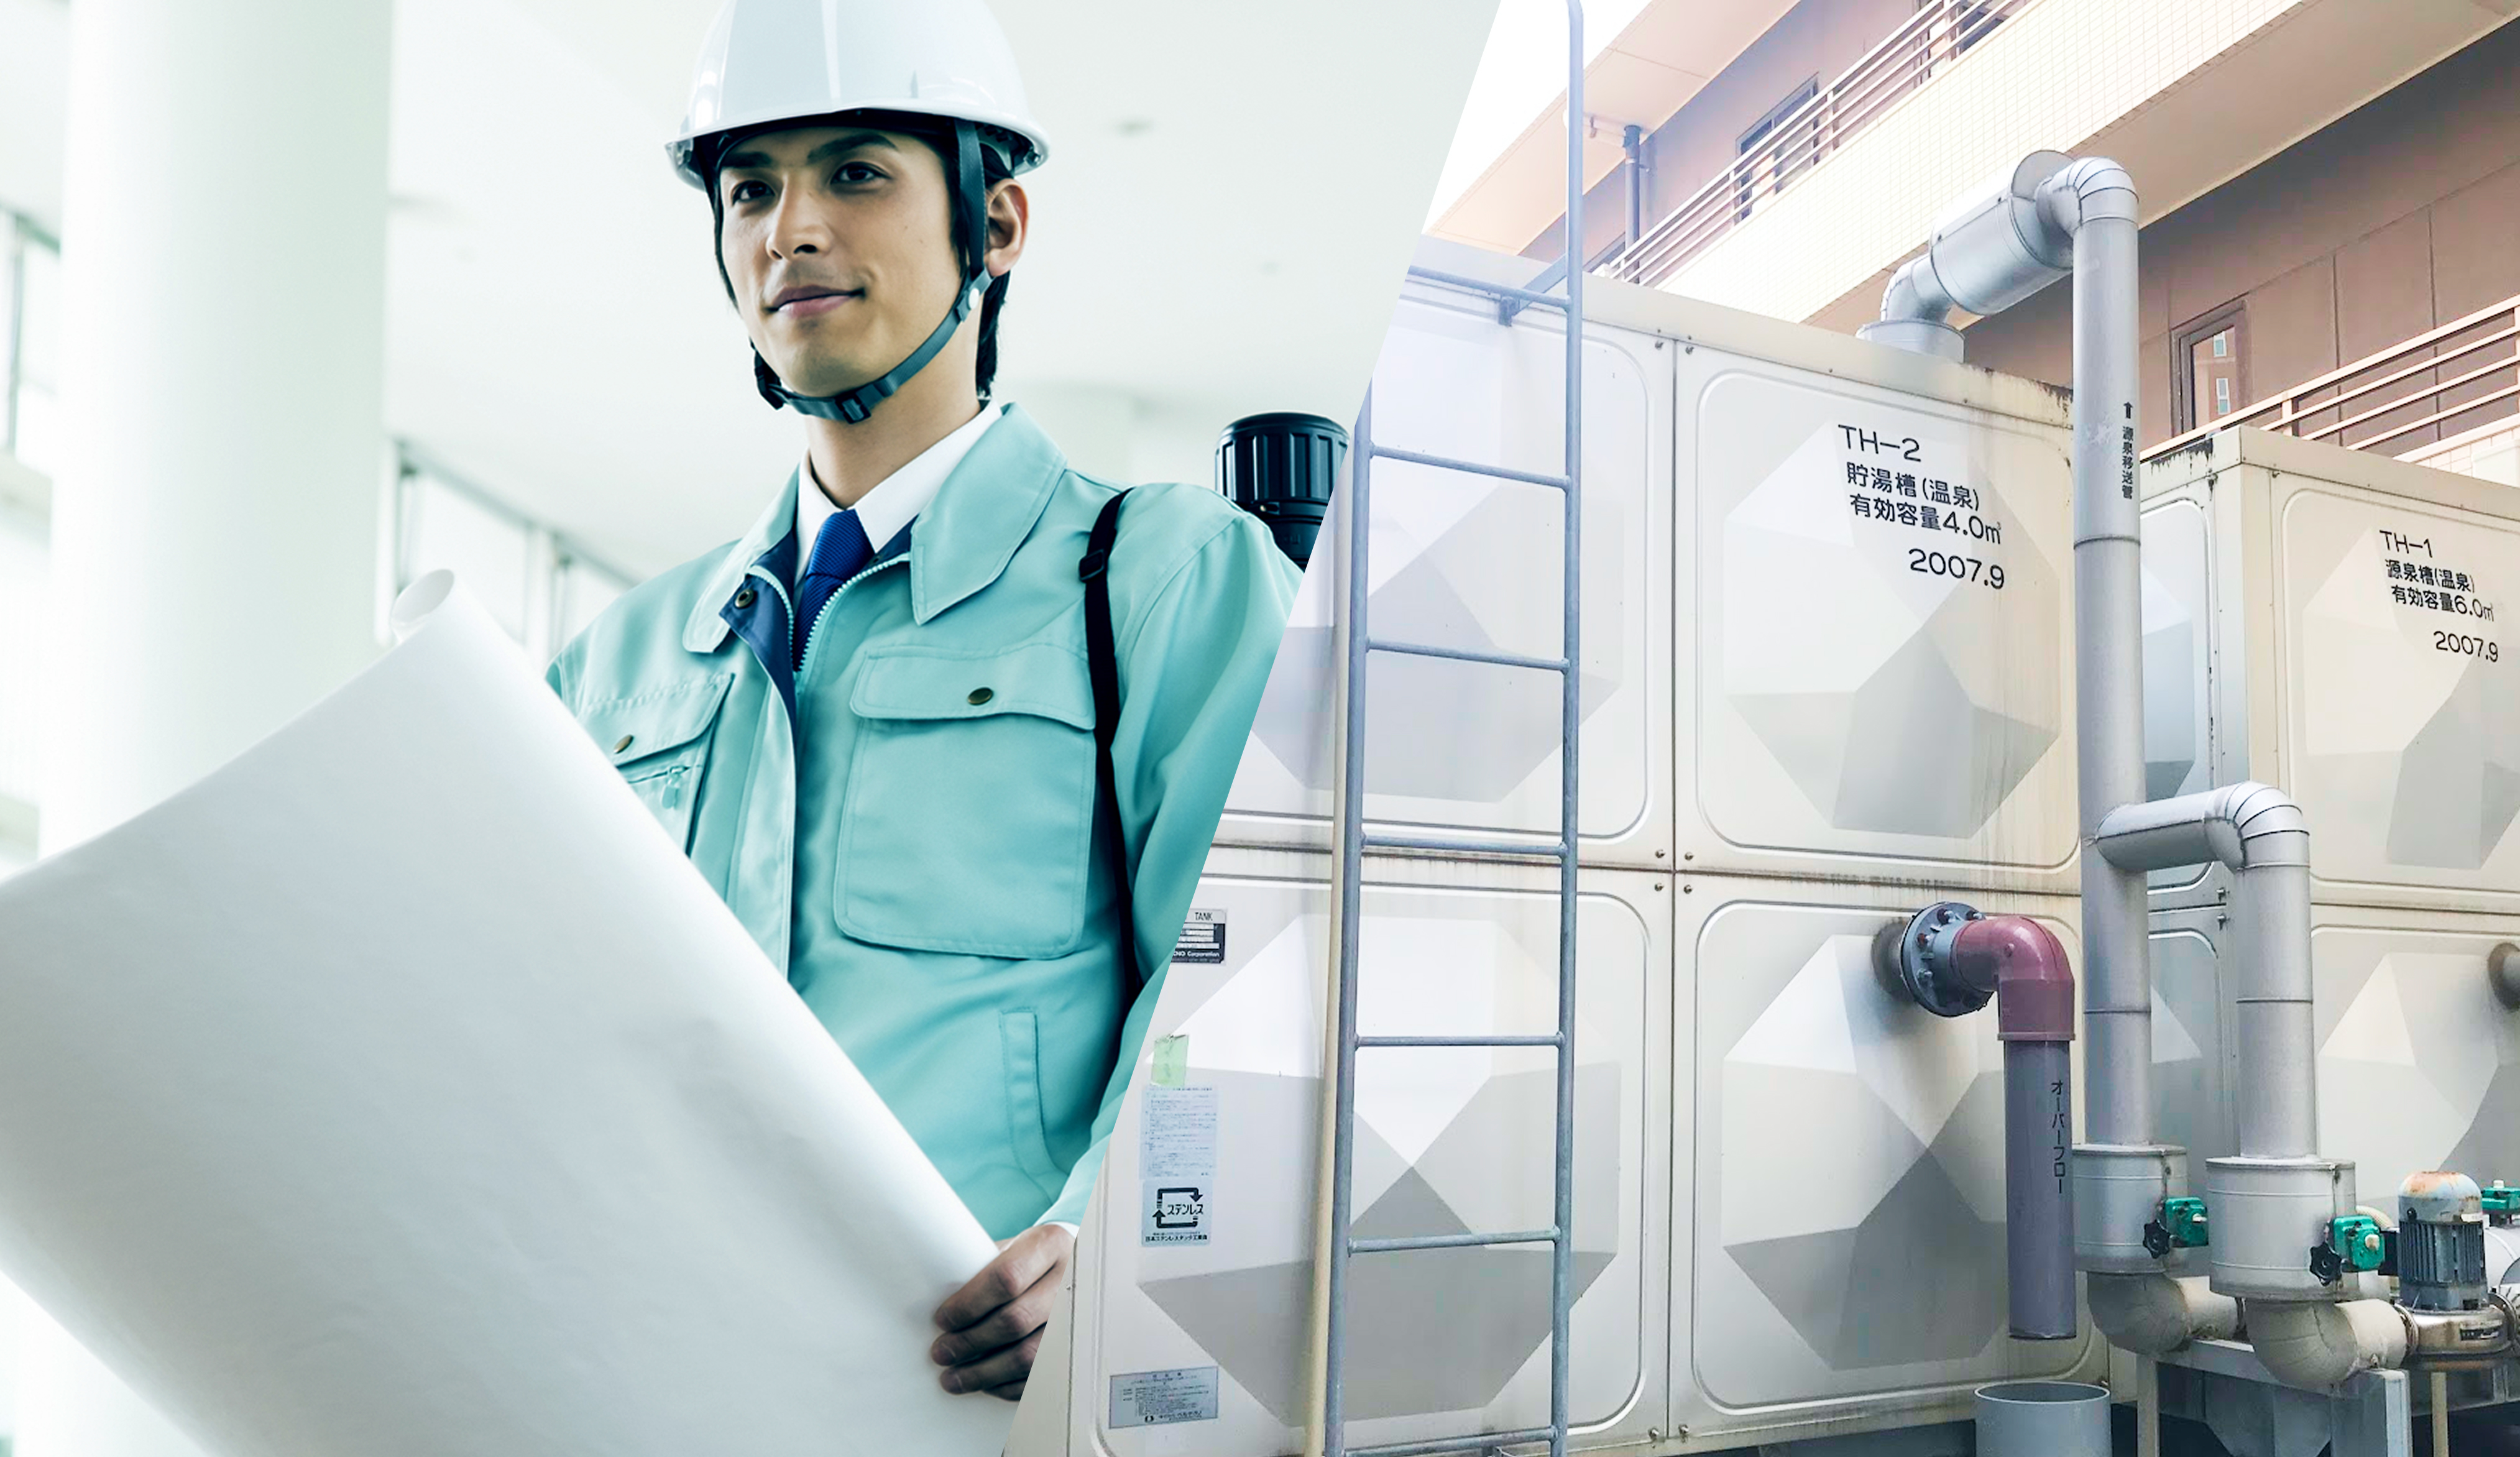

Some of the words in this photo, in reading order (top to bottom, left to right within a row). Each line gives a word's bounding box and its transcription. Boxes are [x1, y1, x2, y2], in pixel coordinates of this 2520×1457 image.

[1838, 424, 1921, 462] TH-2
[1846, 462, 1980, 512] 貯湯槽(温泉)
[2379, 530, 2433, 558] TH-1
[1908, 548, 2005, 590] 2007.9
[2384, 559, 2475, 593] 源泉槽(温泉)
[2433, 630, 2499, 663] 2007.9
[1195, 912, 1213, 921] TANK
[2051, 1080, 2066, 1194] オーバーフロー
[1167, 1204, 1203, 1215] ステンレス
